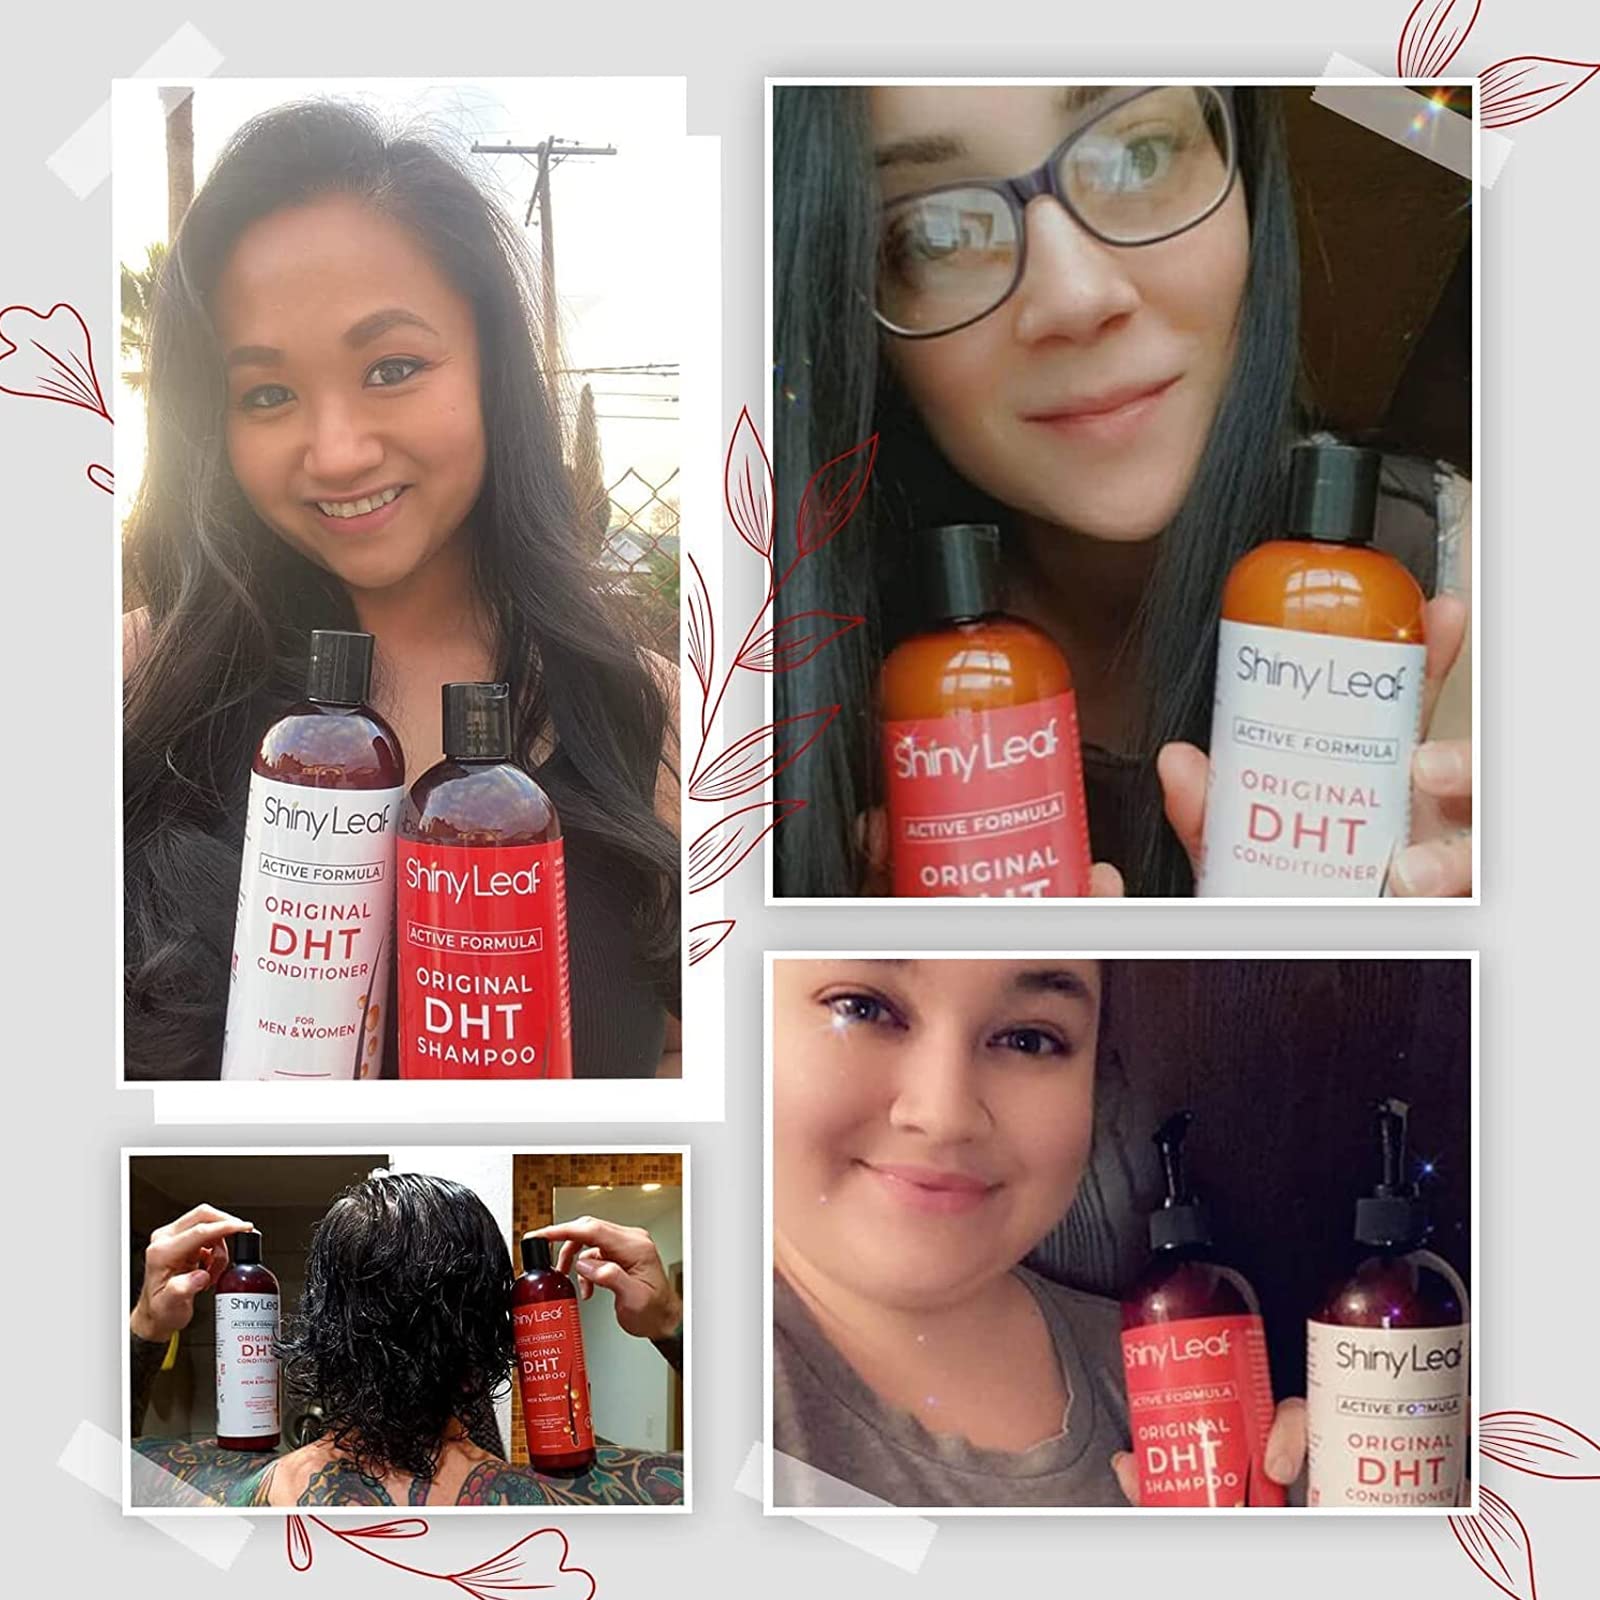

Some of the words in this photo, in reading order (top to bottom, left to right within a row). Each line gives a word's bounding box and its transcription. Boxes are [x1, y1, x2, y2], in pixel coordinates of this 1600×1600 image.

[1236, 645, 1322, 700] Shiny
[1326, 658, 1406, 701] Leaf
[894, 738, 979, 784] Shiny
[982, 717, 1059, 769] Leaf
[1237, 723, 1296, 748] ACTIVE
[1304, 736, 1393, 758] FORMULA
[1241, 769, 1381, 807] ORIGINAL
[263, 796, 329, 841] Shiny
[331, 803, 390, 834] Leaf
[907, 819, 968, 838] ACTIVE
[973, 800, 1061, 832] FORMULA
[1248, 803, 1367, 855] DHT
[262, 859, 309, 878] ACTIVE
[313, 867, 381, 880] FORMULA
[920, 846, 1060, 887] ORIGINAL
[1233, 844, 1378, 880] CONDITIONER
[406, 857, 469, 904] Shiny
[473, 861, 541, 897] Leaf
[265, 896, 371, 920] ORIGINAL
[269, 922, 362, 961] DHT
[410, 927, 455, 948] ACTIVE
[460, 935, 537, 950] FORMULA
[257, 957, 369, 980] CONDITIONER
[416, 967, 533, 995] ORIGINAL
[258, 1018, 287, 1036] MEN
[302, 1024, 356, 1039] WOMEN
[295, 1016, 315, 1025] FOR
[425, 996, 522, 1040] DHT
[417, 1036, 535, 1066] SHAMPOO
[231, 1298, 260, 1312] Shiny
[1170, 1329, 1231, 1361] Leaf
[1336, 1341, 1408, 1378] Shiny
[523, 1357, 559, 1374] DHT
[1165, 1386, 1231, 1404] FORMULA
[1341, 1401, 1391, 1415] ACTIVE
[1138, 1417, 1230, 1440] ORIGINAL
[1347, 1433, 1453, 1451] ORIGINAL
[1147, 1439, 1222, 1473] DHT
[1358, 1457, 1445, 1486] DHT
